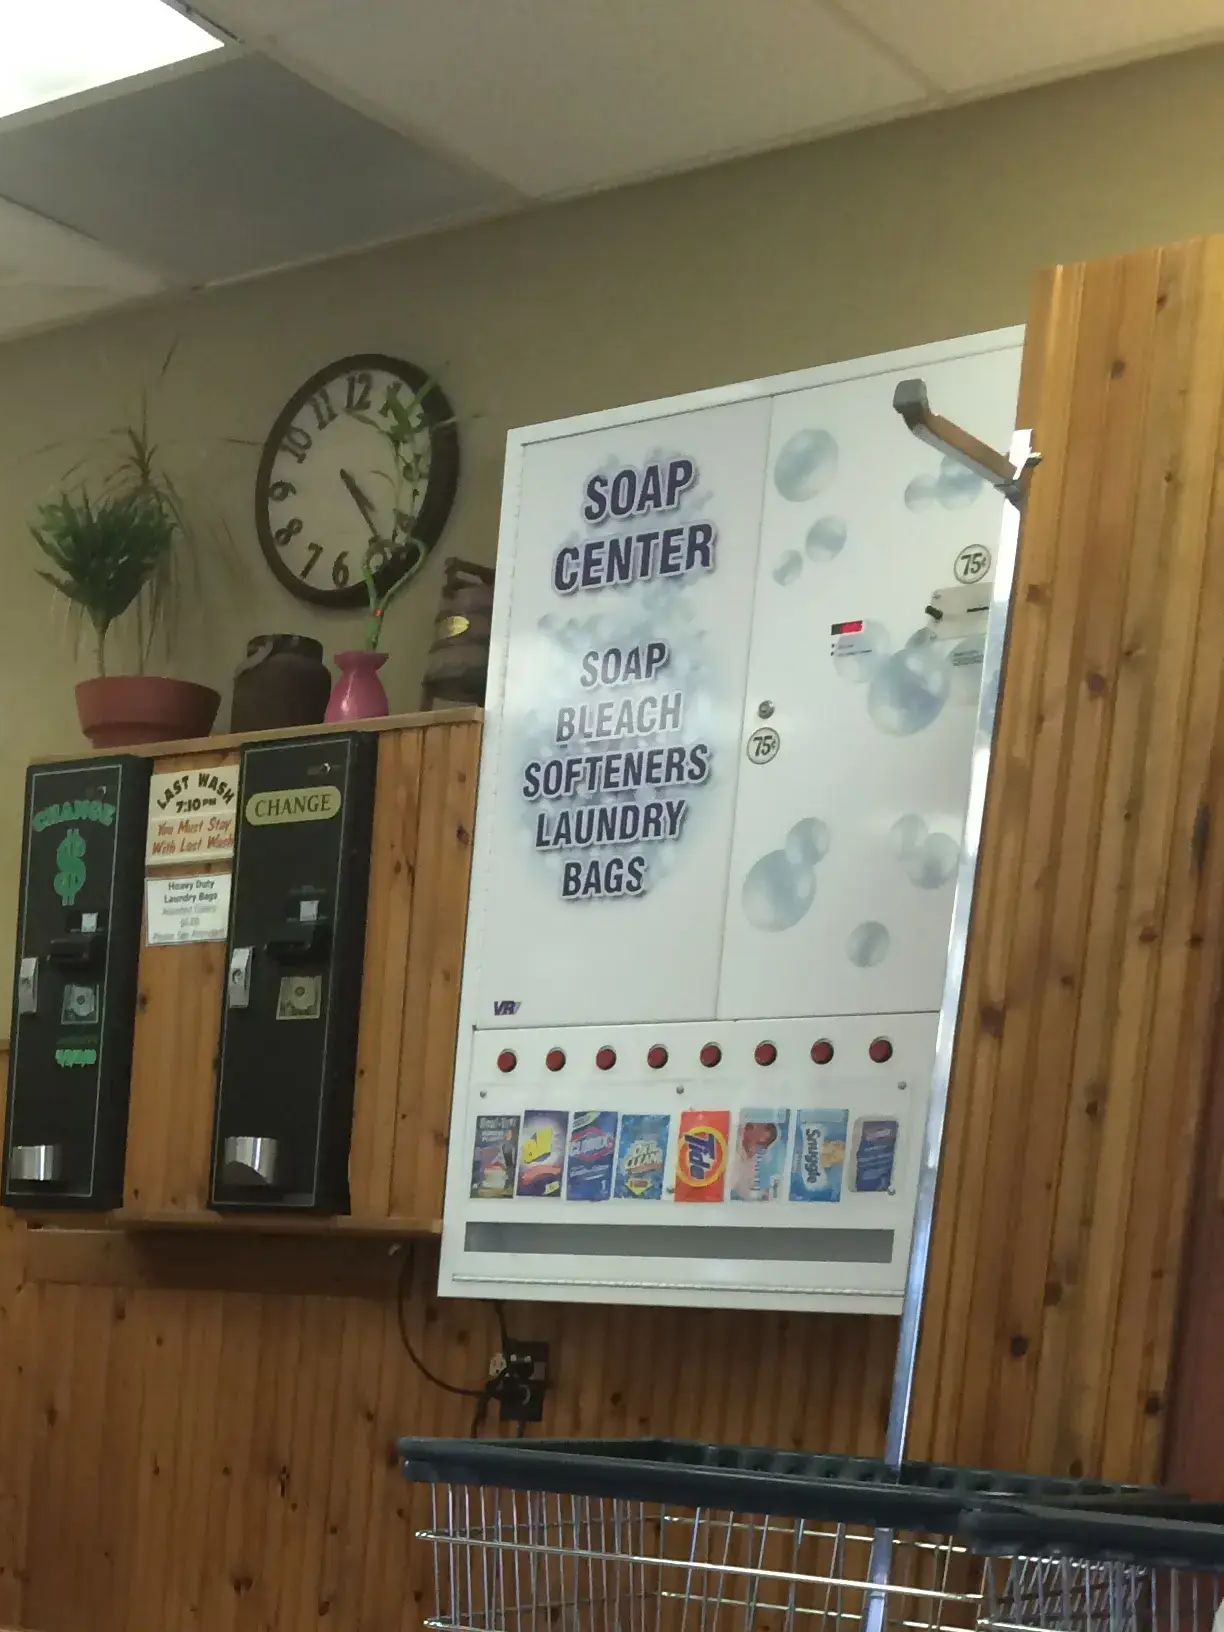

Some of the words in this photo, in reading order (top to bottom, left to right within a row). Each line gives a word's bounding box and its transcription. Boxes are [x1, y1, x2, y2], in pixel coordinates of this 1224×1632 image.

[307, 386, 338, 430] 11
[345, 373, 372, 411] 12
[278, 424, 313, 464] 10
[269, 480, 297, 502] 9
[584, 459, 695, 521] SOAP
[275, 518, 304, 546] 8
[299, 542, 324, 580] 7
[331, 551, 350, 589] 6
[553, 524, 714, 592] CENTER
[580, 642, 667, 689] SOAP
[556, 692, 683, 744] BLEACH
[522, 744, 709, 798] SOFTENERS
[156, 775, 190, 810] LAST
[198, 773, 235, 806] WASH
[254, 794, 332, 819] CHANGE
[157, 821, 175, 836] You
[178, 819, 204, 834] Must
[207, 816, 233, 833] Stay
[535, 800, 686, 848] LAUNDRY
[152, 840, 176, 855] With
[180, 837, 203, 853] Last
[207, 833, 235, 849] Wash
[168, 881, 194, 891] Heavy
[196, 880, 215, 890] Duty
[561, 856, 646, 897] BAGS
[164, 893, 196, 904] Laundry
[198, 892, 218, 902] Bags
[684, 1132, 716, 1180] Tide
[804, 1128, 821, 1183] Snuggle
